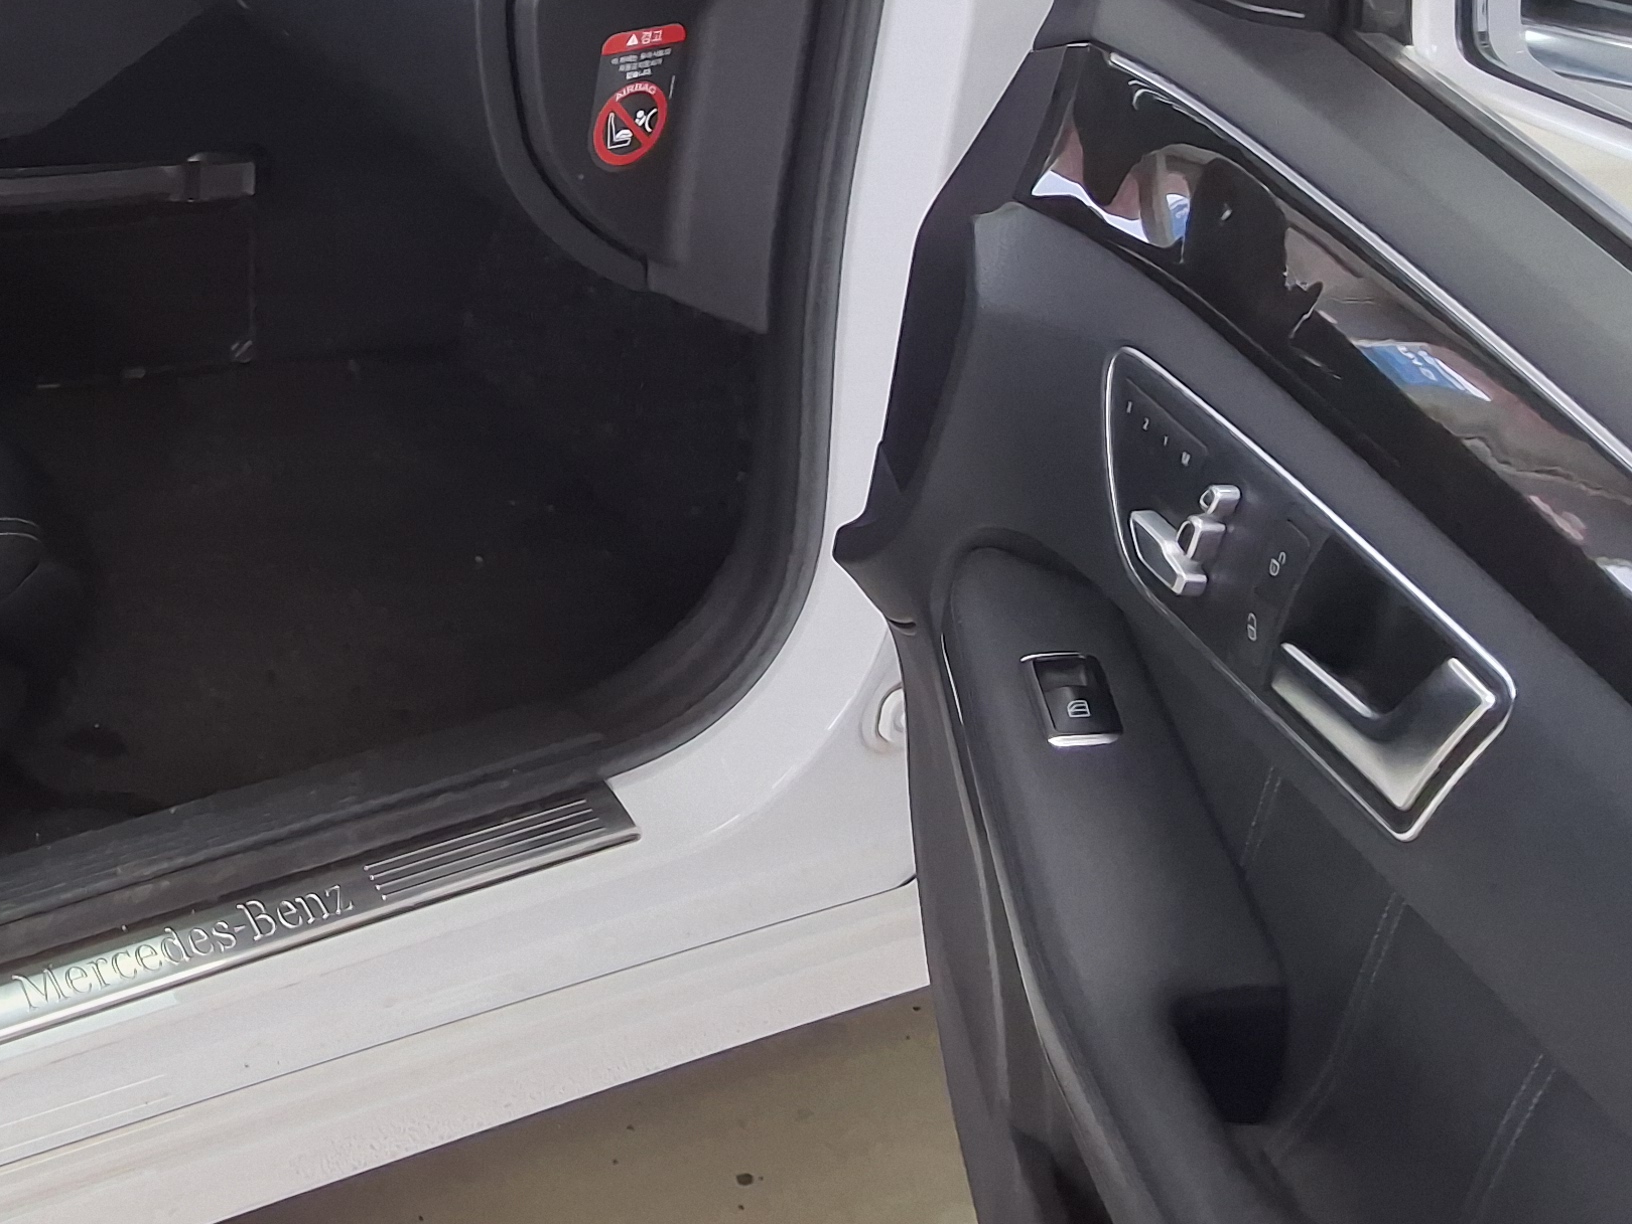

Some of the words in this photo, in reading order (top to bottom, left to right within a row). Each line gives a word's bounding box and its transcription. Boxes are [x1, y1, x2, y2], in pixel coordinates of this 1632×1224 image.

[641, 29, 663, 45] 경고
[615, 83, 657, 102] AIRBAG
[11, 884, 356, 1011] Mercedes-Benz
